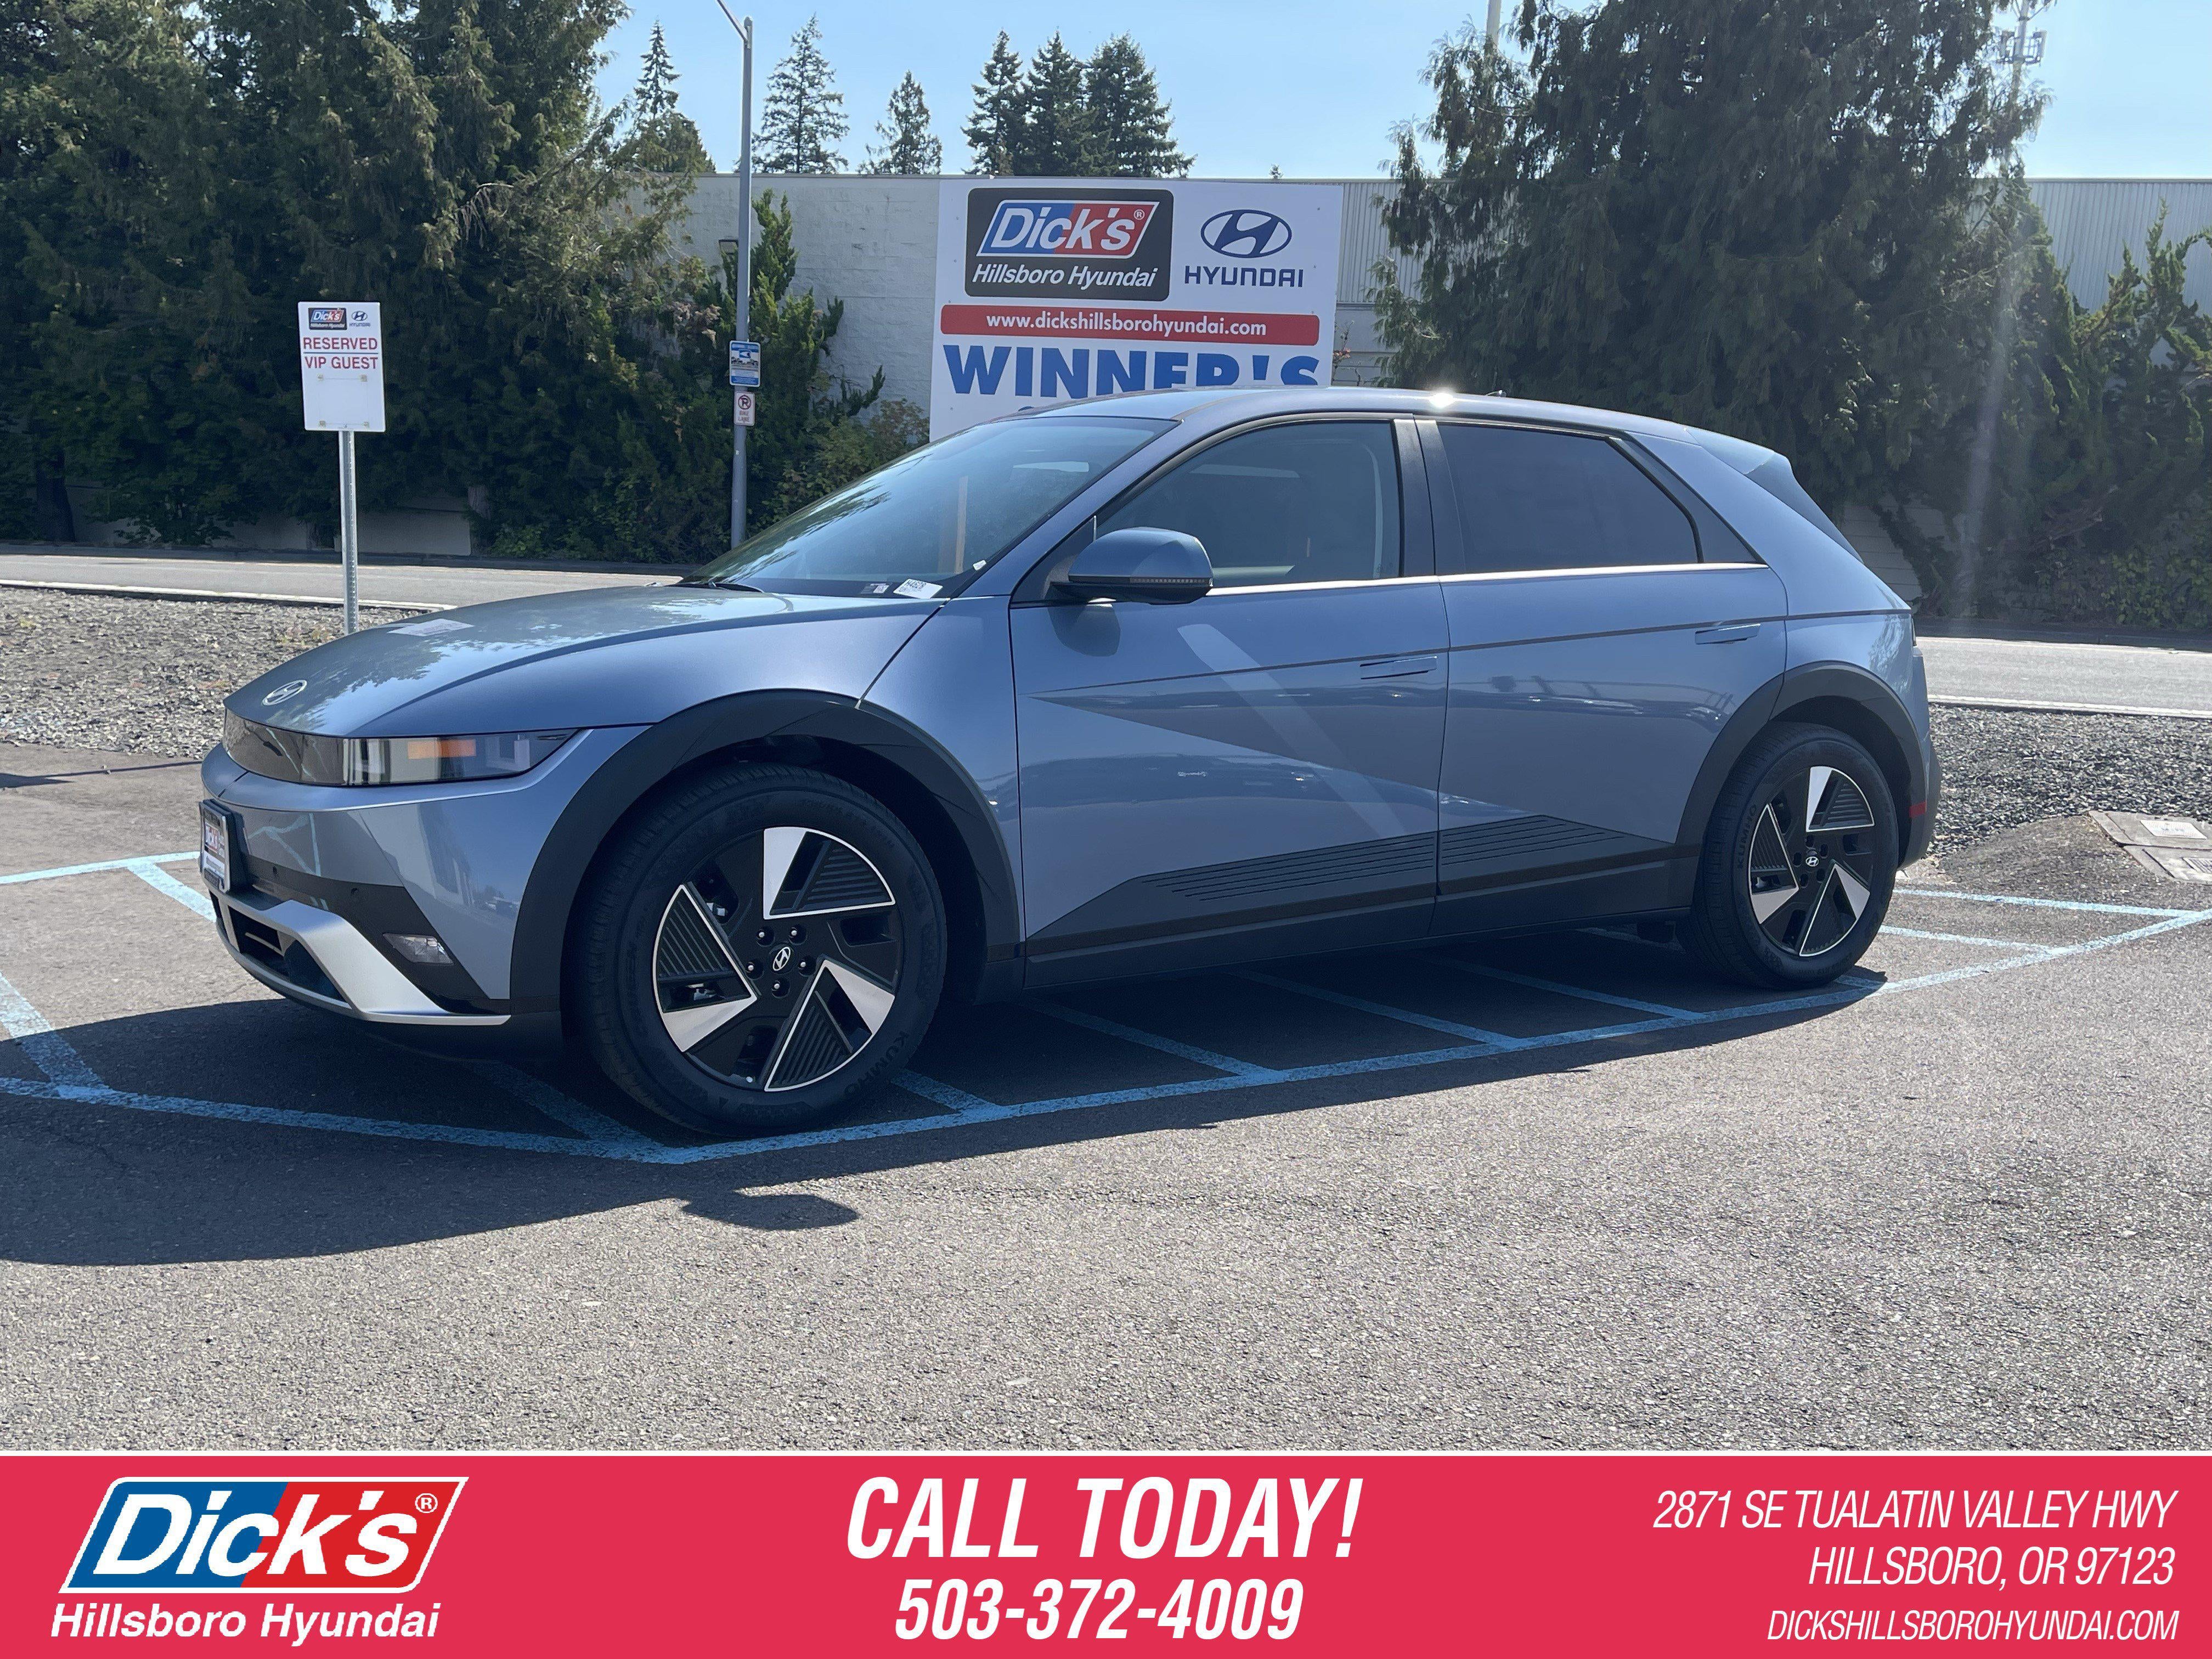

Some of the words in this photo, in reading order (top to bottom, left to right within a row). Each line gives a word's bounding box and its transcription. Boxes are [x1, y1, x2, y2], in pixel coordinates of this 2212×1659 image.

[990, 206, 1137, 251] Dick's
[973, 264, 1064, 285] Hillsboro
[1068, 266, 1158, 290] Hyundai
[1184, 266, 1304, 287] HYUNDAI
[986, 311, 1267, 337] www.dickshillsborohyundai.com
[303, 337, 378, 350] RESERVED
[304, 356, 326, 369] VIP
[331, 357, 379, 369] GUEST
